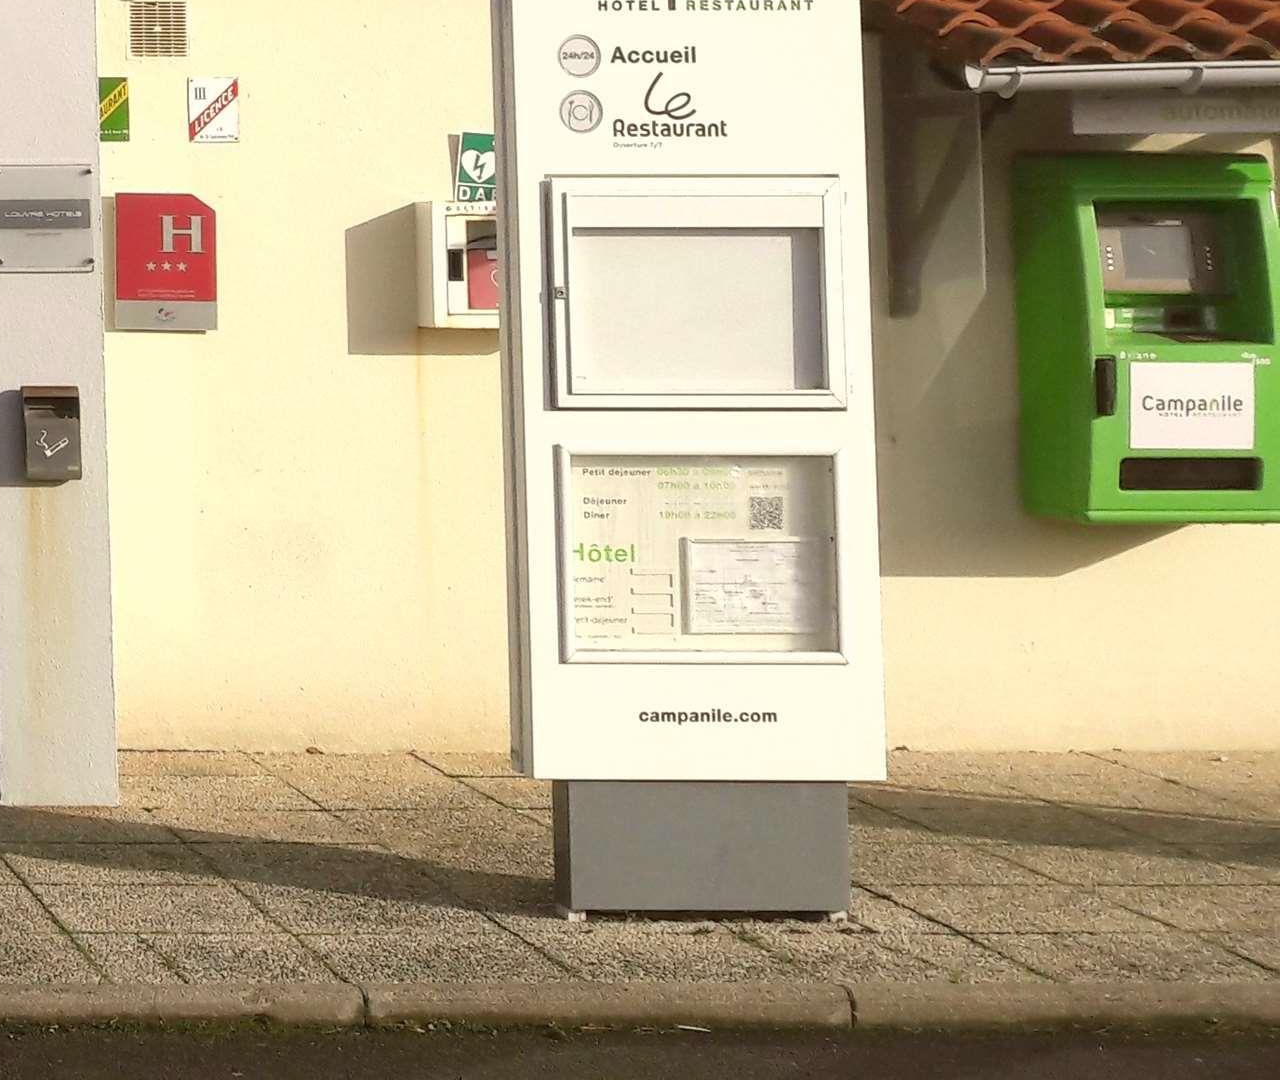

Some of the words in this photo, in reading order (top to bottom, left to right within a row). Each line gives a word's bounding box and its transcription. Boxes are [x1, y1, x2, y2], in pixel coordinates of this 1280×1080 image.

[597, 0, 660, 11] HOTEL
[686, 0, 815, 11] RESTAURANT
[610, 46, 696, 63] Accueil
[644, 71, 696, 120] Le
[195, 86, 235, 132] LICENCE
[613, 119, 728, 137] Restaurant
[158, 214, 207, 253] H
[1142, 395, 1243, 417] Campanile
[638, 708, 778, 726] campanile.com
